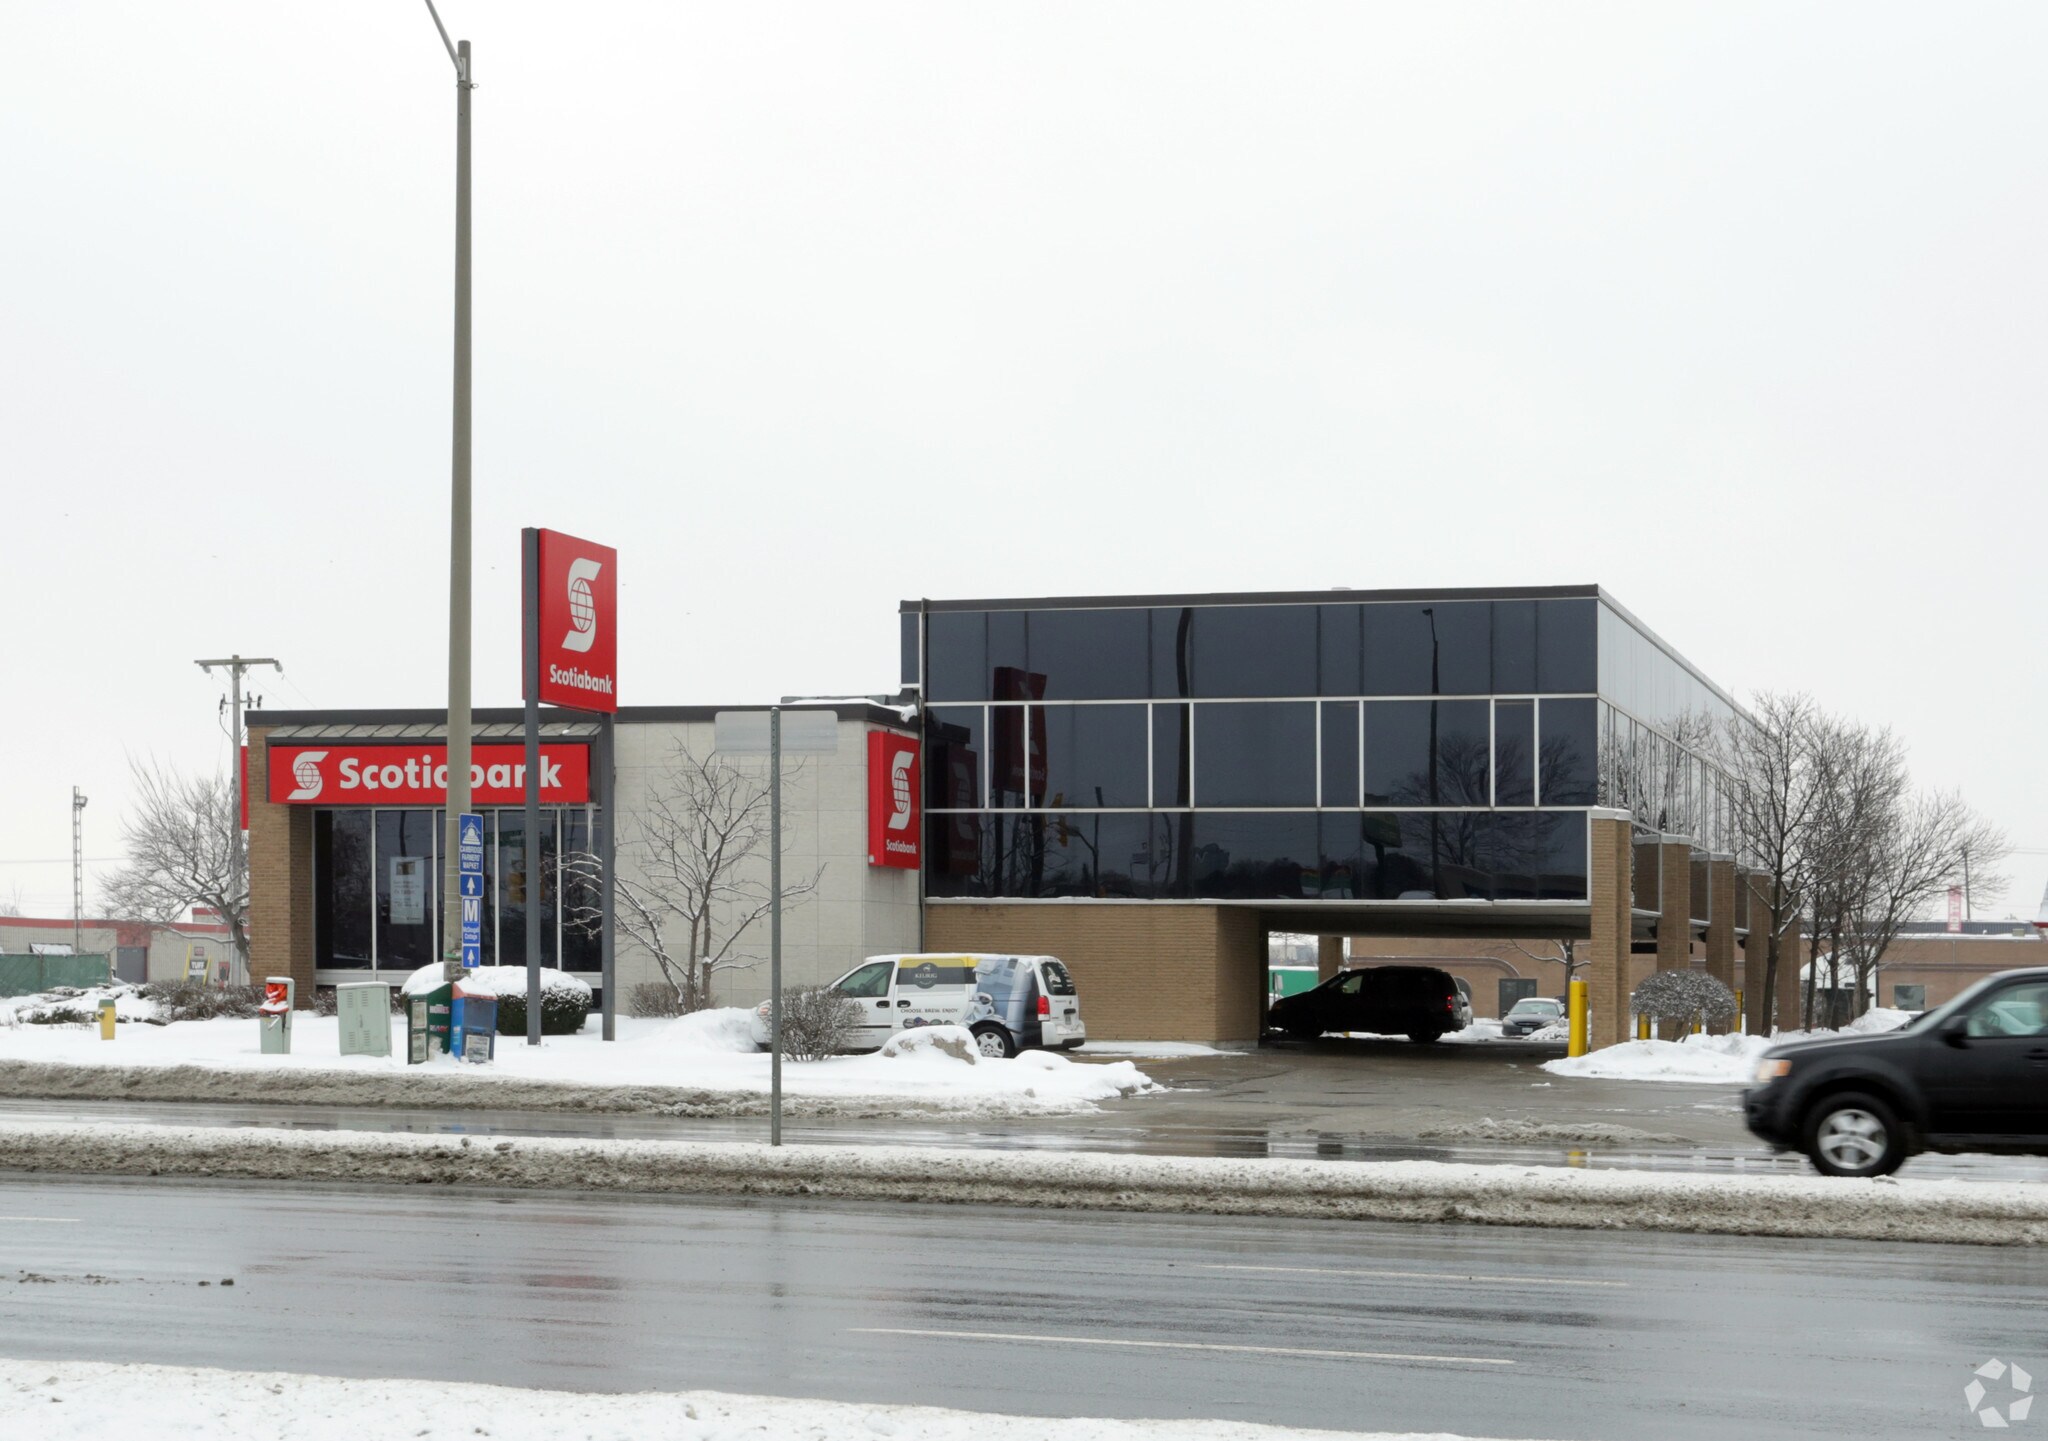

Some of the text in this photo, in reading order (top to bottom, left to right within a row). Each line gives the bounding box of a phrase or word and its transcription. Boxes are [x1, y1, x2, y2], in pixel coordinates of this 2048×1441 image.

[549, 664, 613, 694] Scotiabank
[886, 839, 916, 854] Scotiabank
[462, 861, 479, 869] MARKET
[464, 899, 478, 921] M
